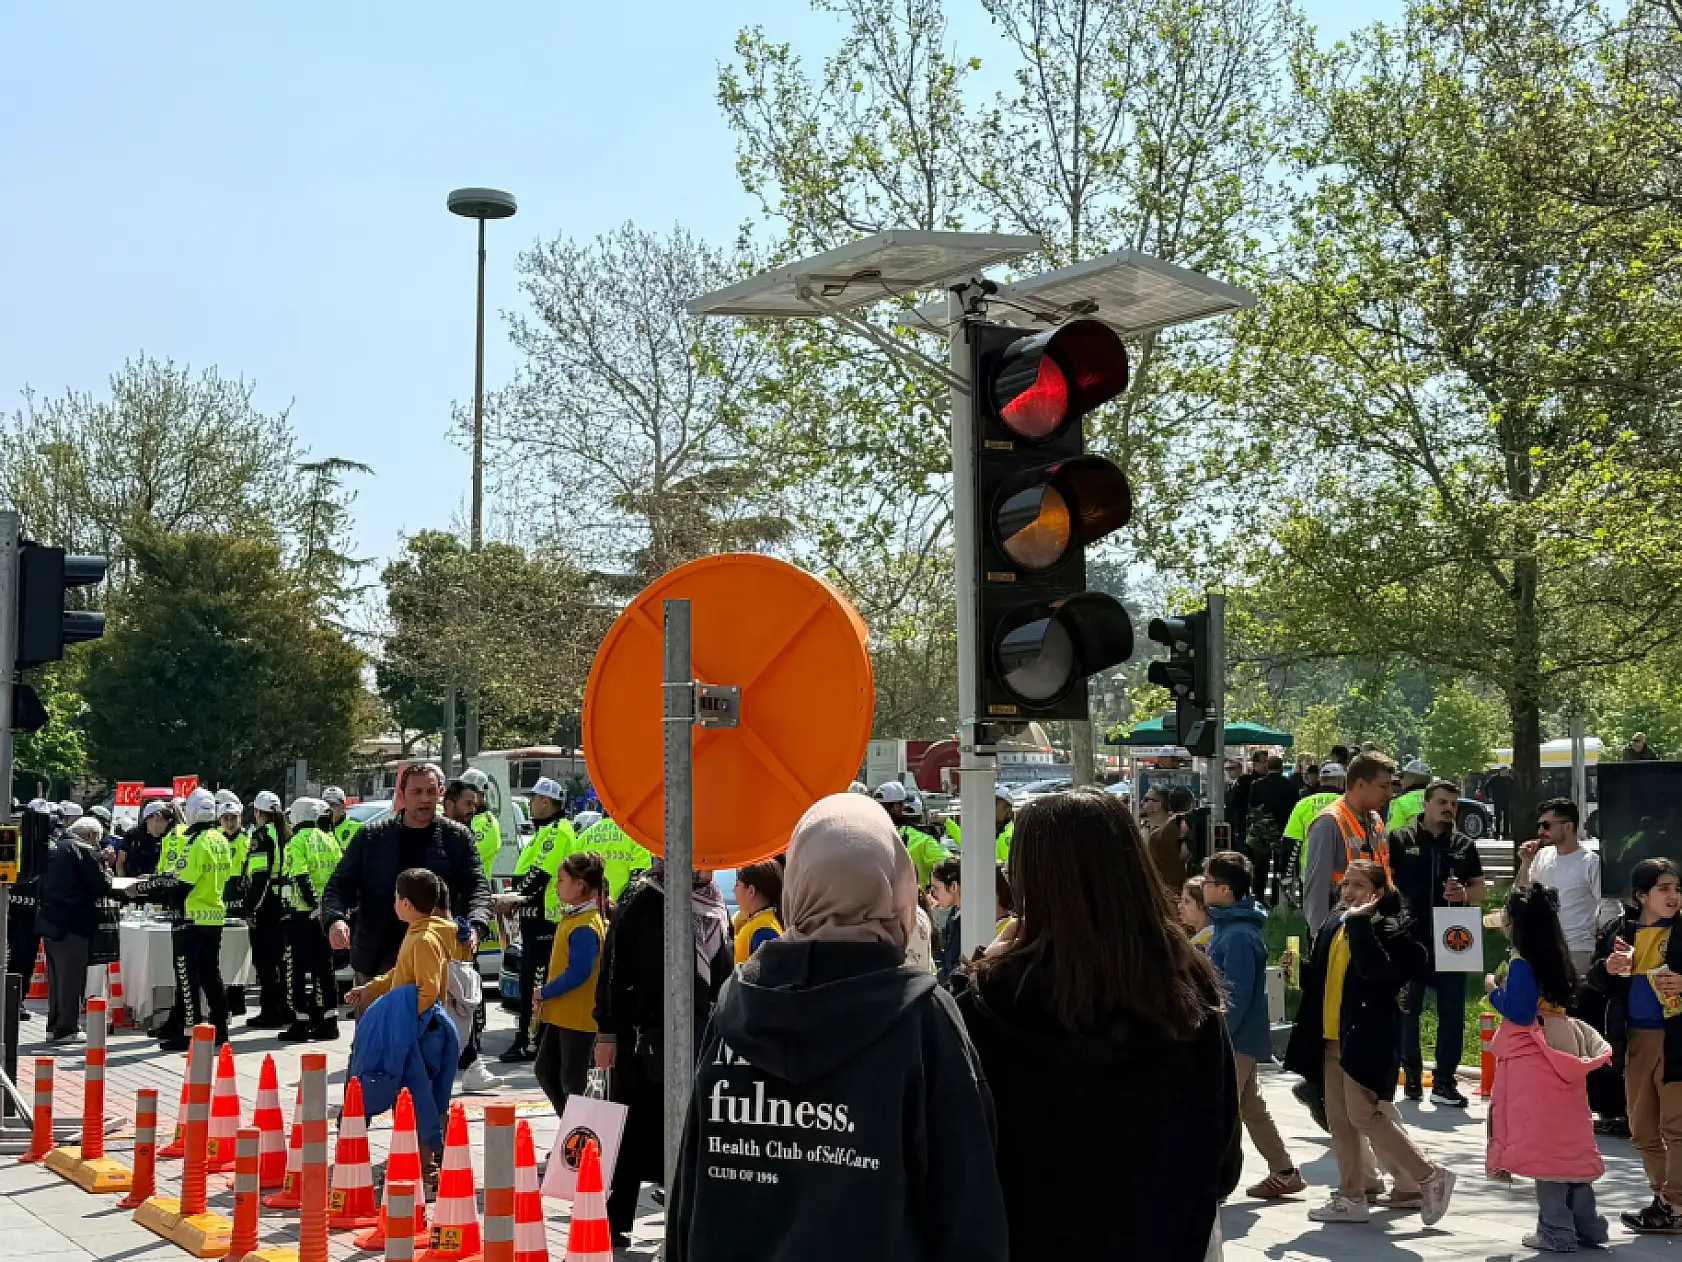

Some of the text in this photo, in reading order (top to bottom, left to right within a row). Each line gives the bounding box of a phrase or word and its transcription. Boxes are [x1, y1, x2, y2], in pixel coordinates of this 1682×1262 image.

[708, 1080, 855, 1134] fulness.
[708, 1136, 881, 1171] Health Club of Self-Care
[708, 1165, 738, 1180] CLUB
[739, 1169, 755, 1182] OF
